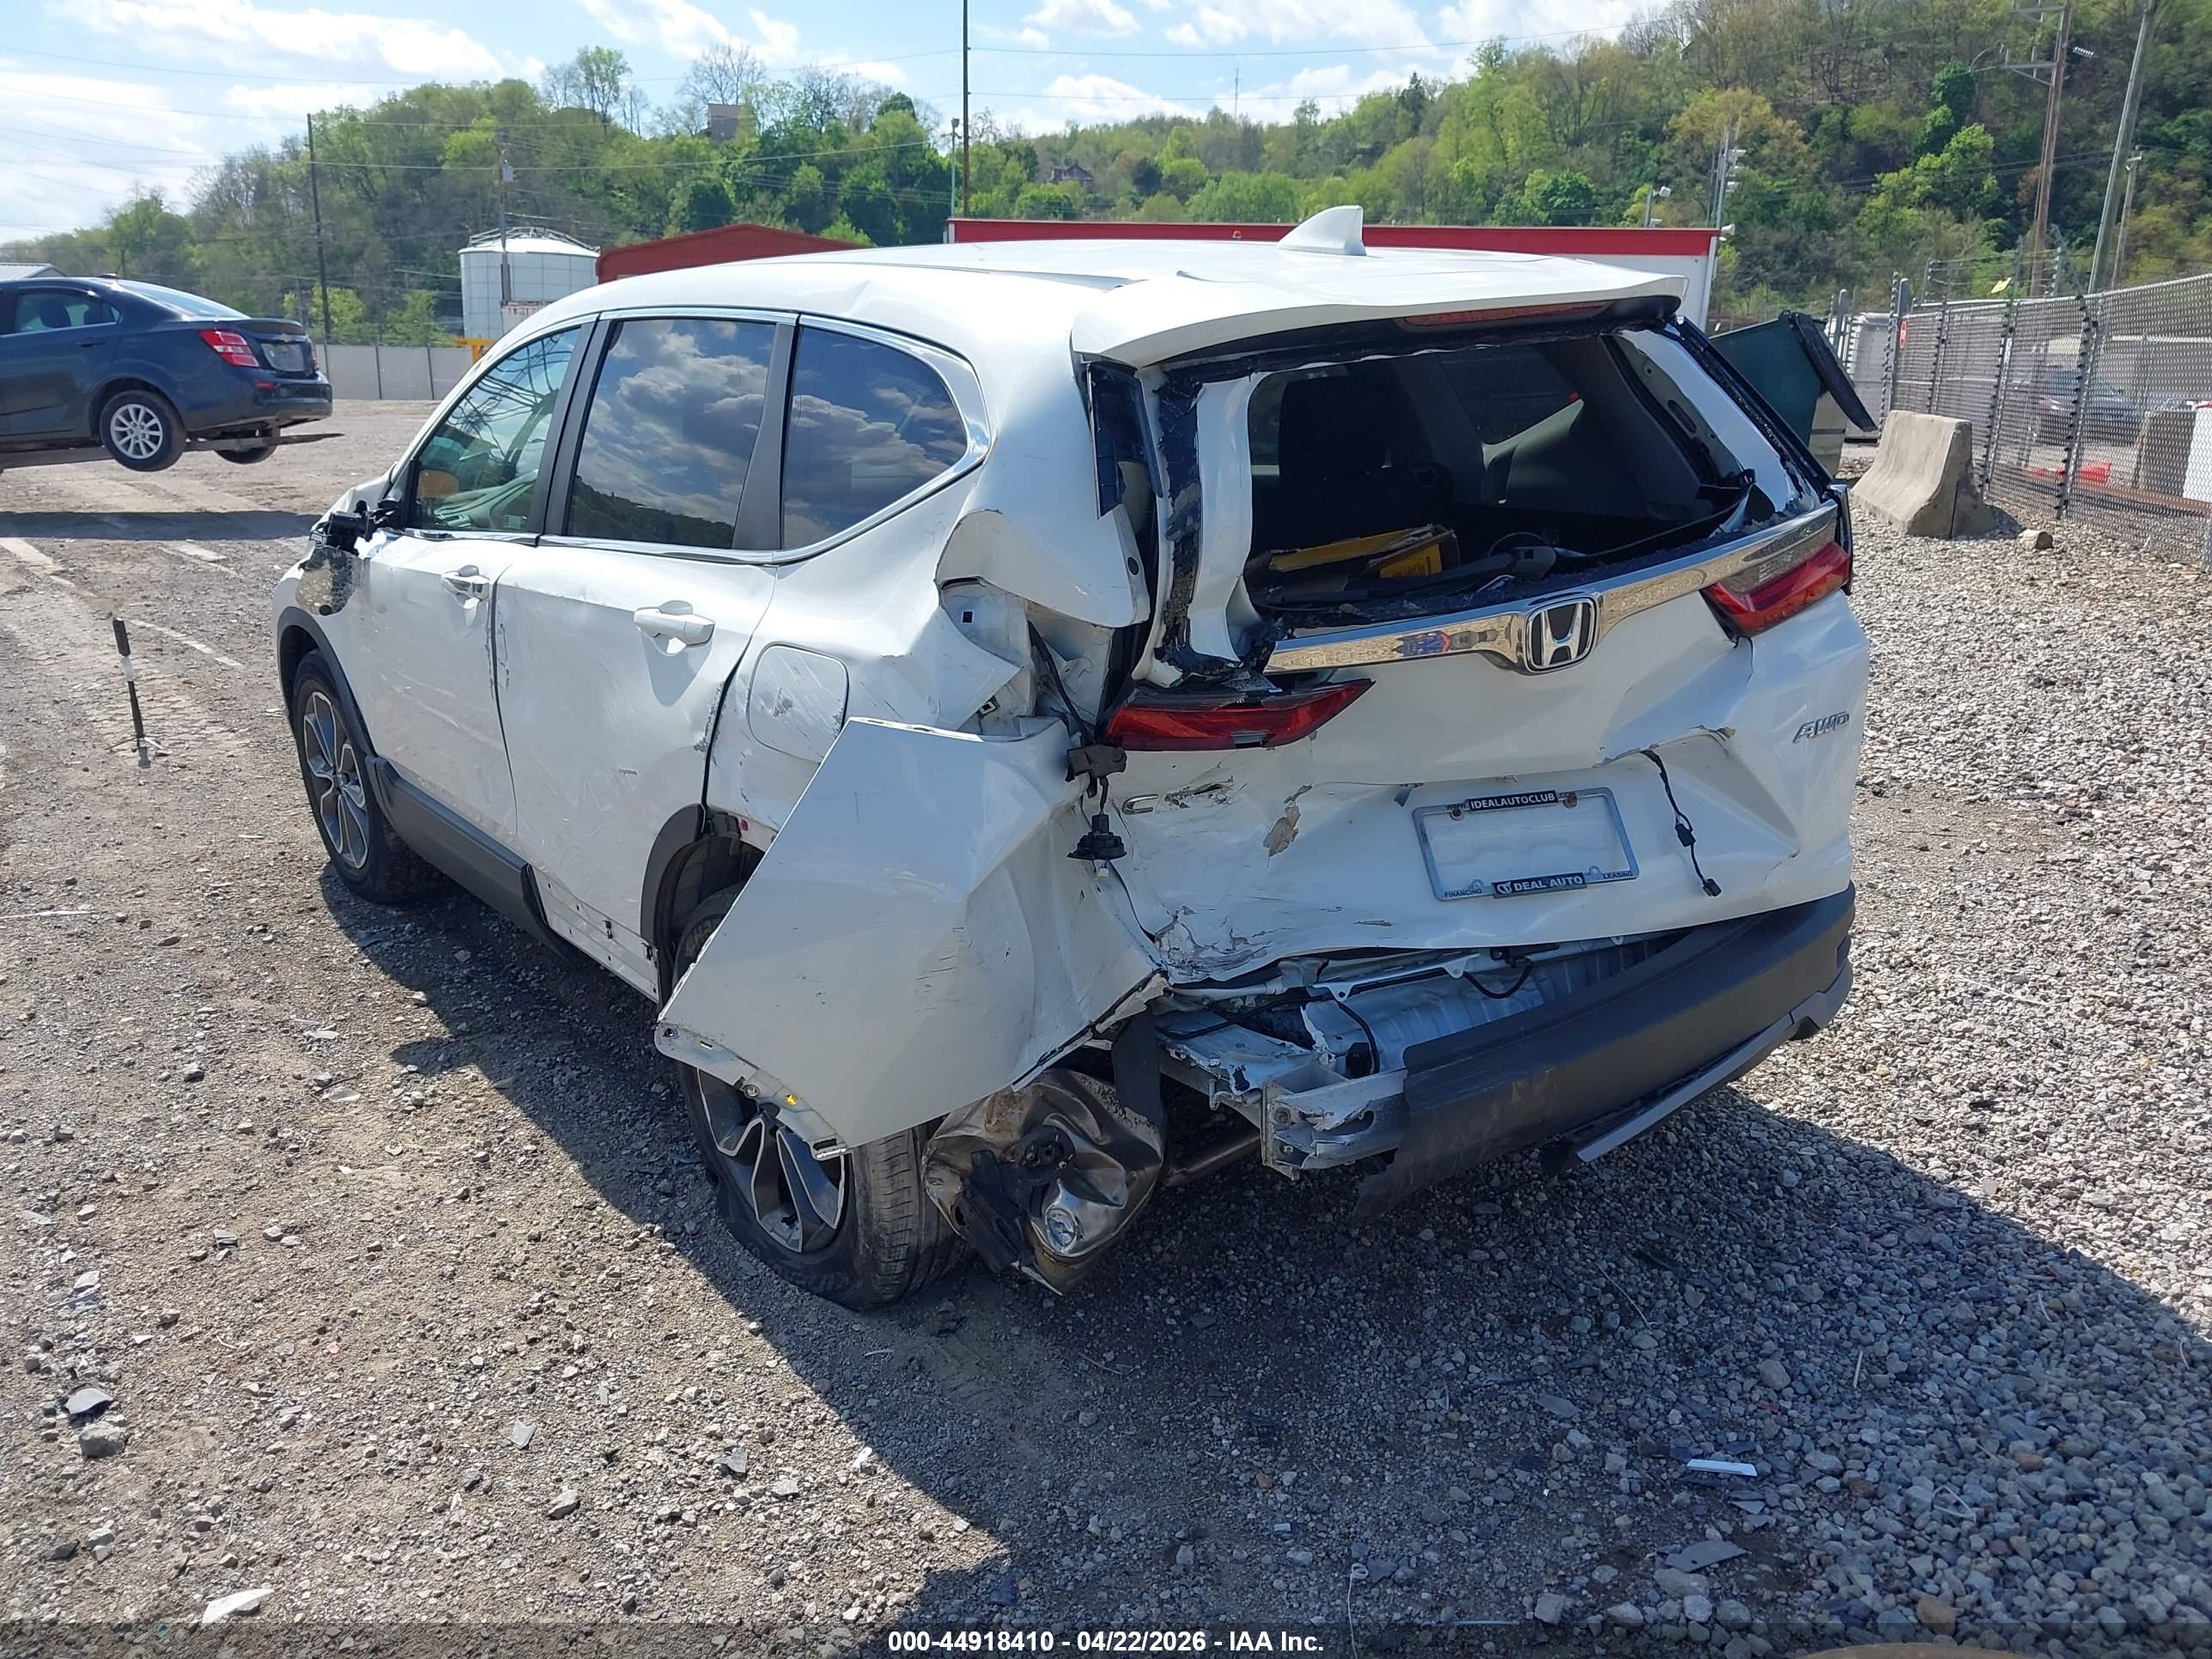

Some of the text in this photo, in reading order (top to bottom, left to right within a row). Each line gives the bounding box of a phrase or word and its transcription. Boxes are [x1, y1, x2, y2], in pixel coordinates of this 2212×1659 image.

[1792, 710, 1850, 744] AWD
[1470, 793, 1556, 810] IDEALAUTOCLUB
[1550, 875, 1583, 888] AUTO
